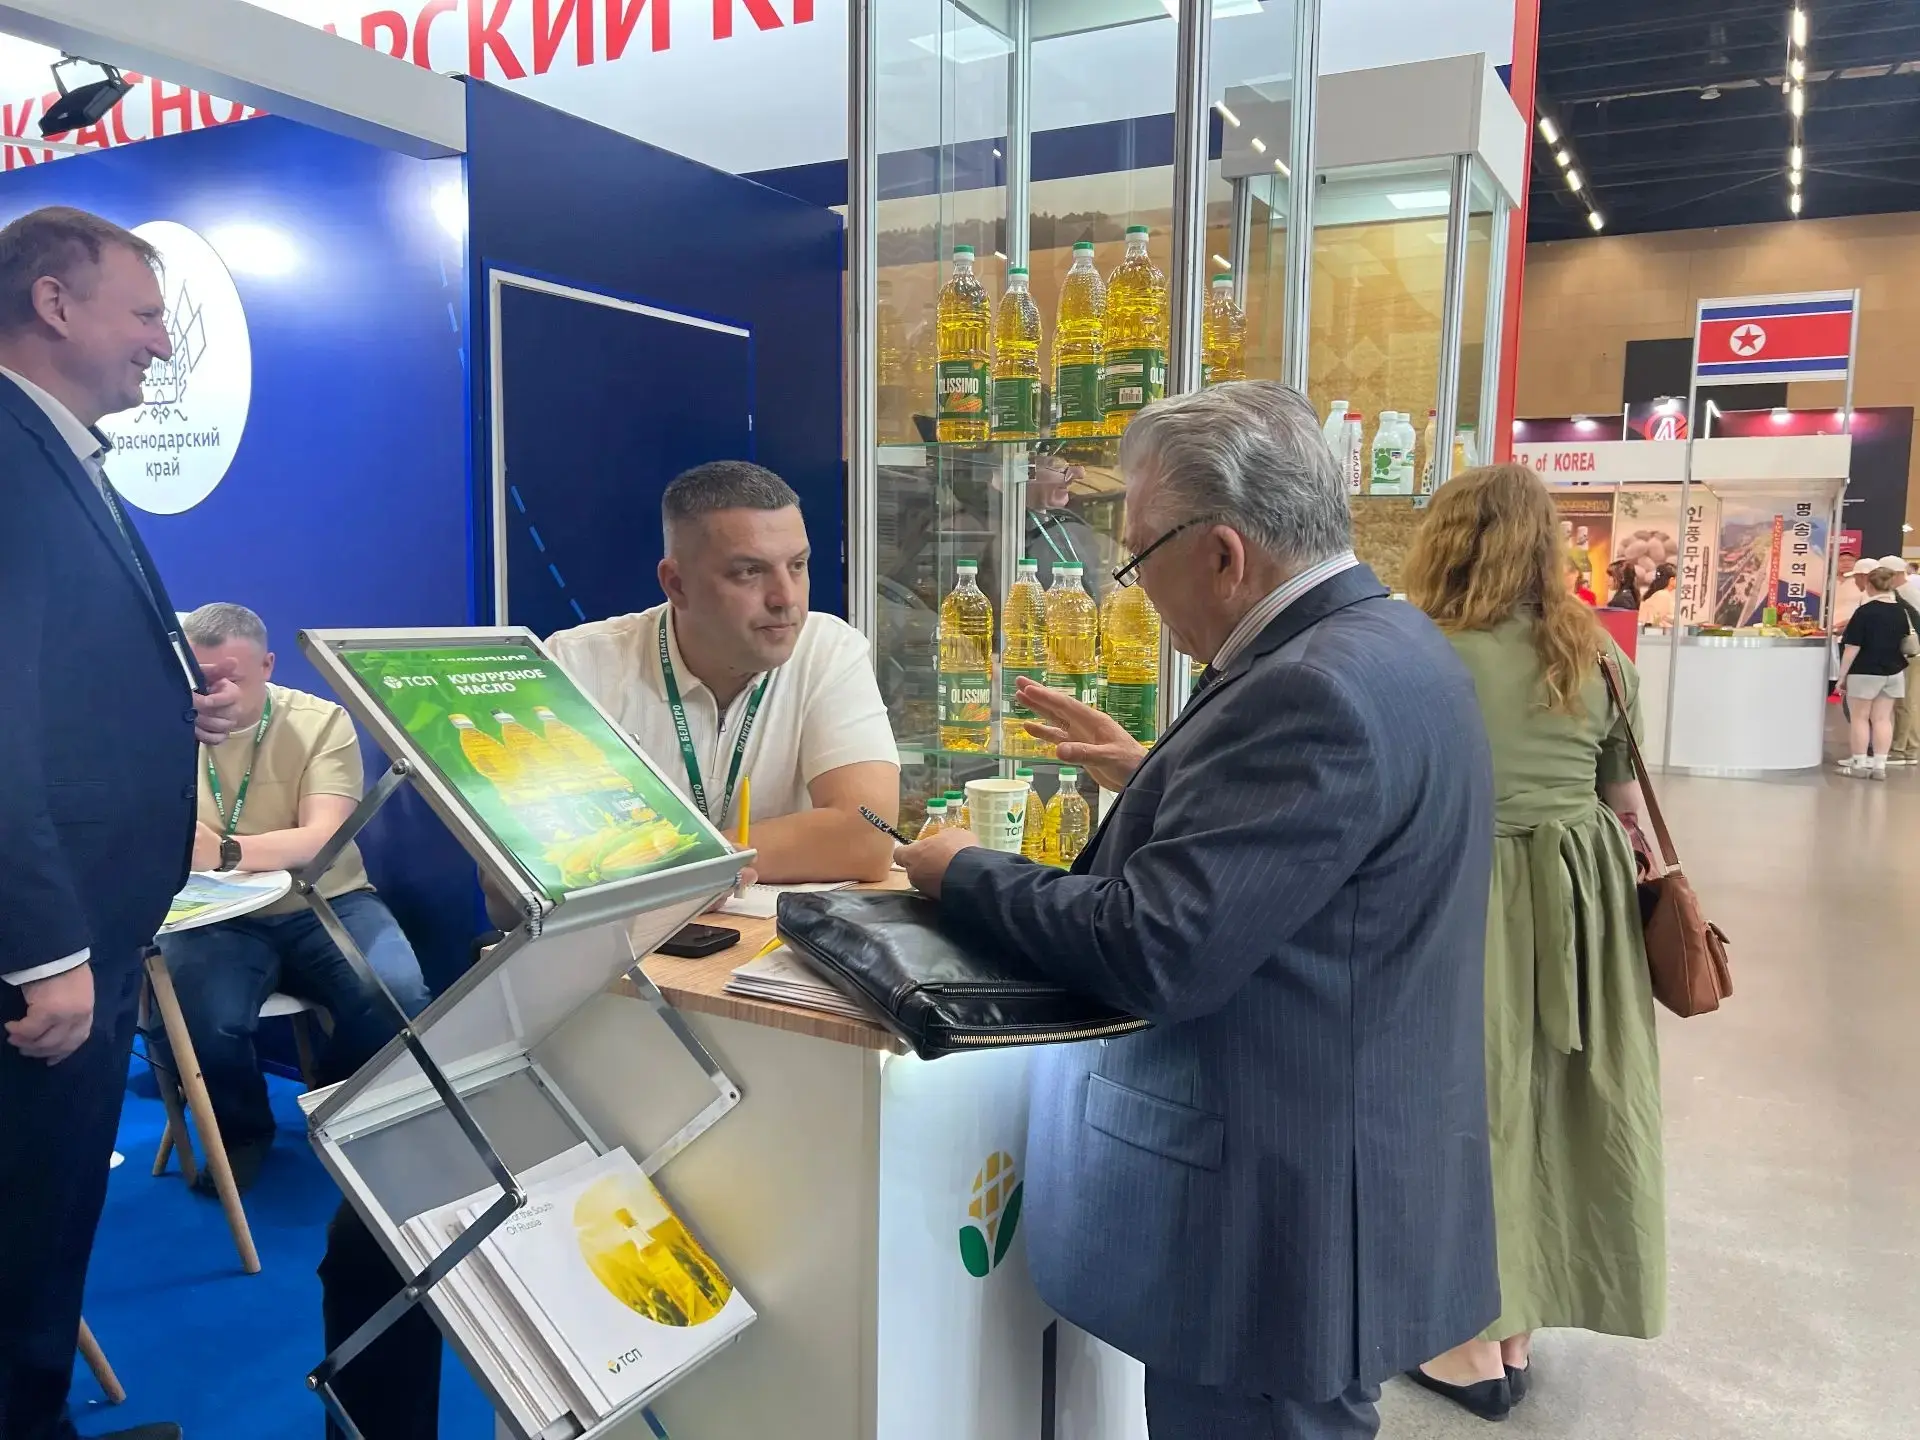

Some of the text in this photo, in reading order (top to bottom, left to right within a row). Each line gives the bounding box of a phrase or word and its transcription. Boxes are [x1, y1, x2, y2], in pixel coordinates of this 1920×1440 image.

[107, 427, 221, 455] Краснодарский
[145, 458, 180, 482] край
[1535, 453, 1548, 473] of
[1554, 452, 1596, 472] KOREA
[659, 628, 670, 664] БЕЛАГРО
[401, 675, 439, 688] ТСП
[446, 668, 547, 685] КУКУРУЗНОЕ
[455, 682, 517, 696] МАСЛО
[950, 688, 991, 704] OLISSIMO
[672, 704, 690, 742] БЕЛАГРО
[736, 714, 753, 753] БЕЛАГРО
[693, 783, 708, 817] ЕЛАГРО
[618, 1348, 643, 1367] ТСП
